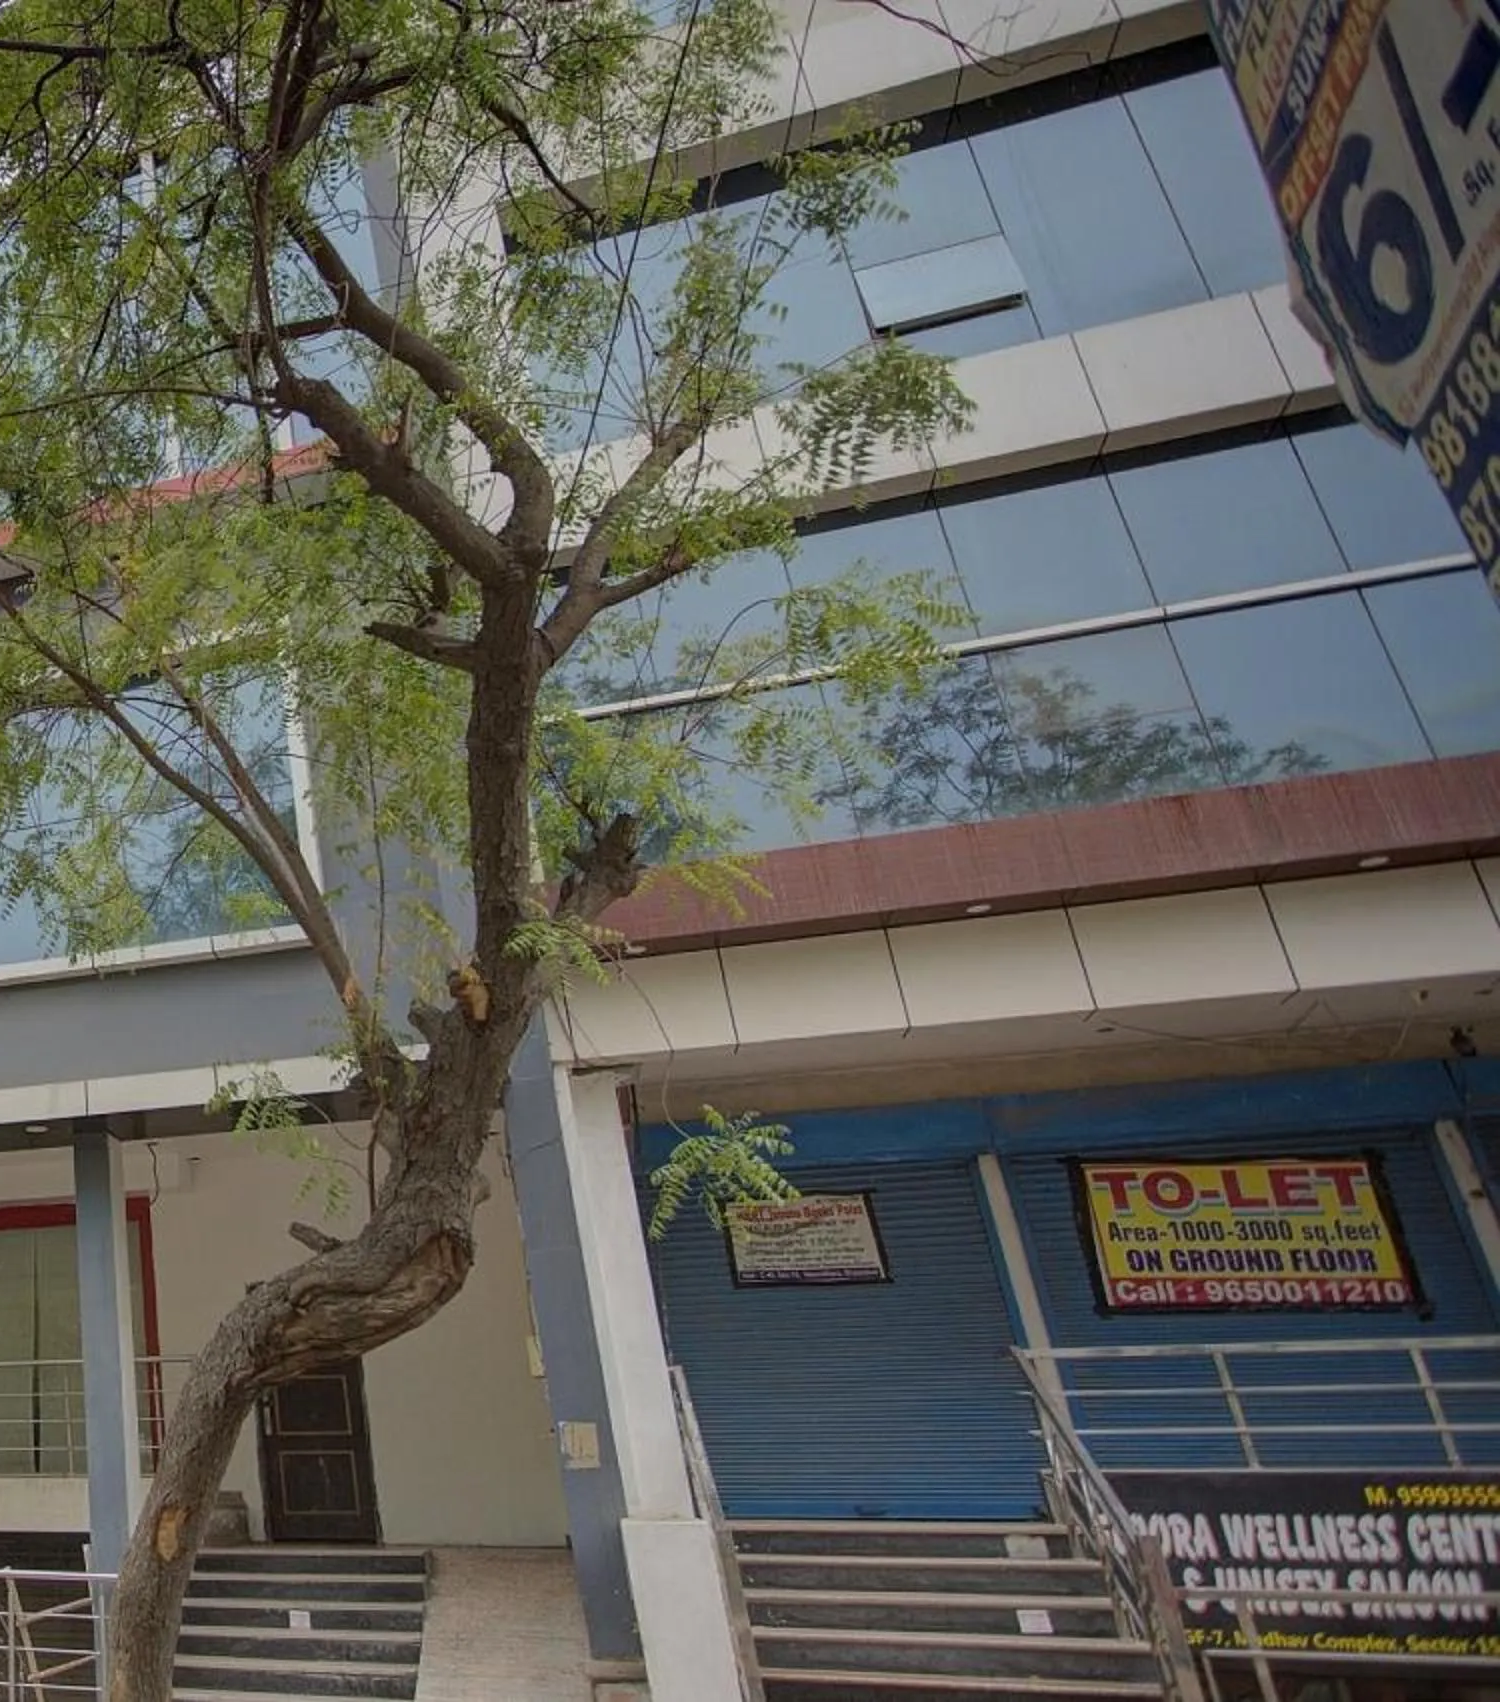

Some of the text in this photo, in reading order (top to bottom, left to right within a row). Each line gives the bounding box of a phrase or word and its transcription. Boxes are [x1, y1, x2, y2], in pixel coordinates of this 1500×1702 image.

[1092, 1167, 1368, 1215] TO-LET
[1126, 1248, 1379, 1273] ON GROUND FLOOR
[1115, 1279, 1176, 1303] Call
[1203, 1279, 1406, 1303] 9650011210
[1219, 1512, 1401, 1563] WELLNESS
[1347, 1568, 1490, 1622] SALOON
